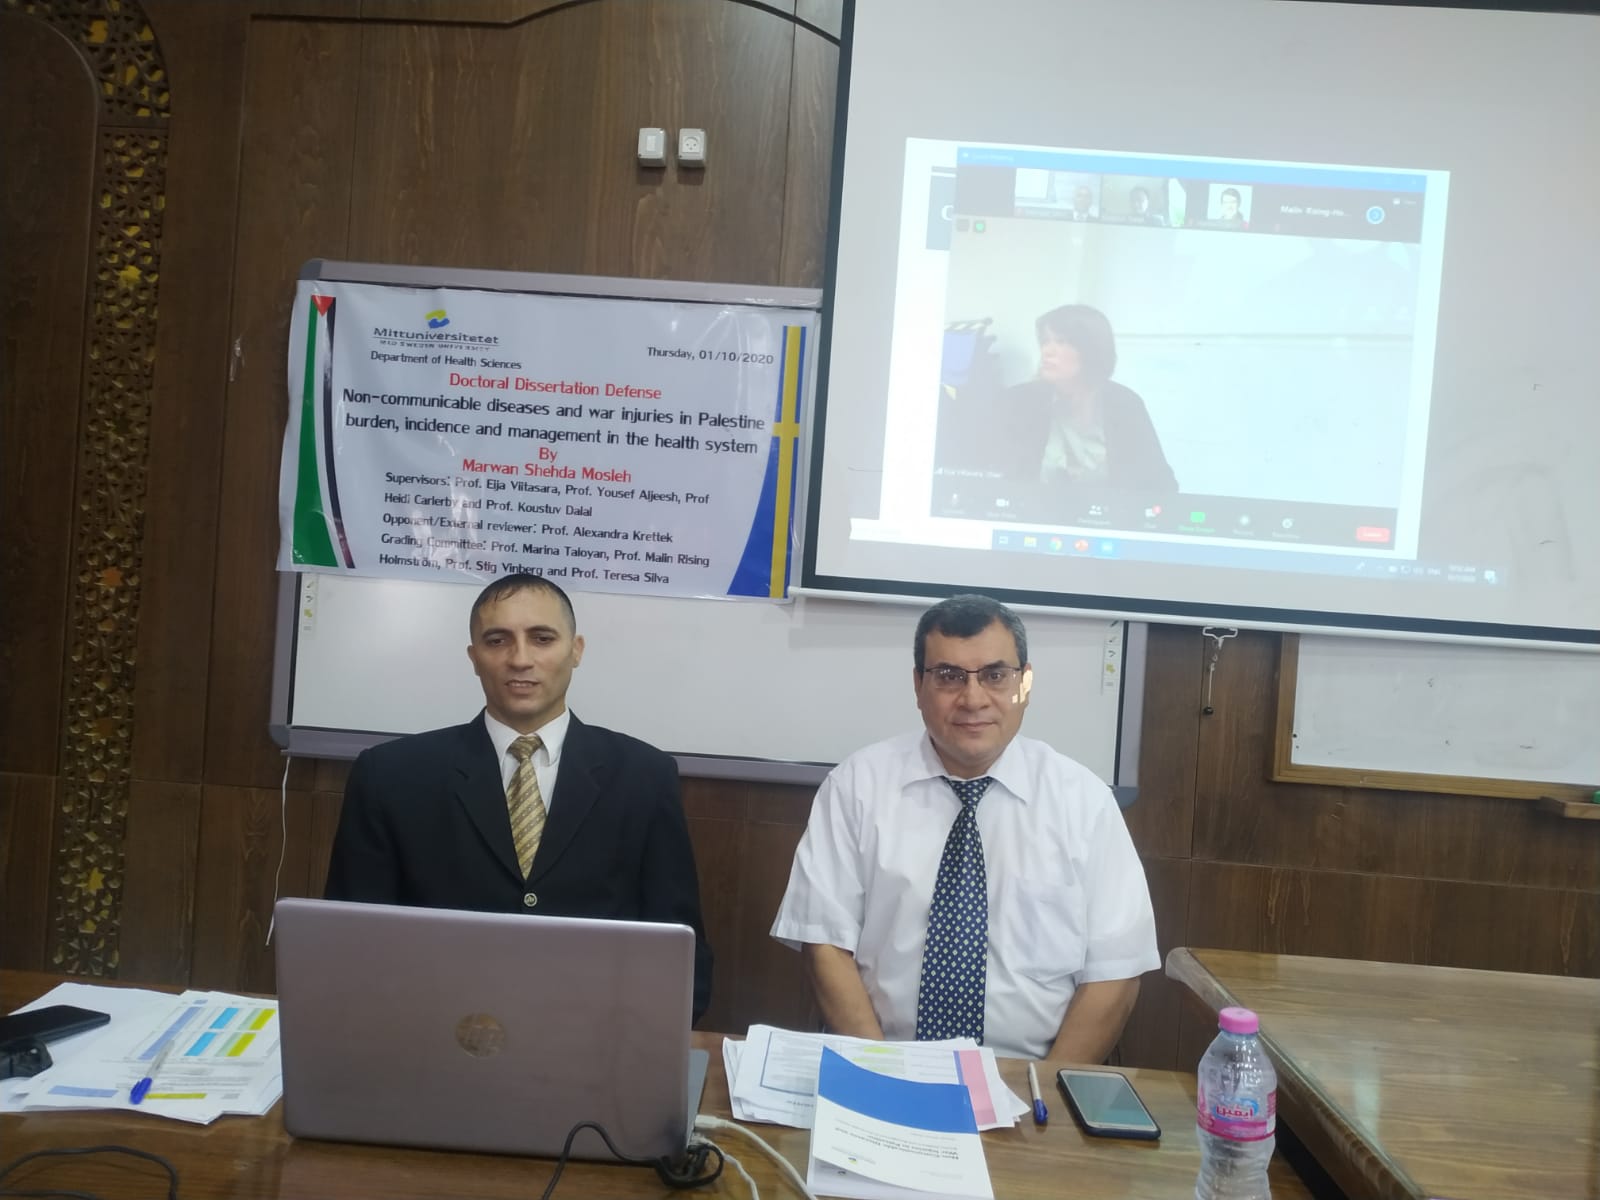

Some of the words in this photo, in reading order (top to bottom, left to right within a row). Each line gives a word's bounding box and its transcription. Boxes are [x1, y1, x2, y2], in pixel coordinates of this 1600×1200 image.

[374, 327, 499, 344] Mittuniversitetet
[400, 341, 435, 349] SWEDEN
[371, 350, 428, 364] Department
[431, 355, 442, 364] of
[445, 355, 476, 367] Health
[480, 358, 522, 370] Sciences
[648, 347, 695, 361] Thursday,
[699, 350, 774, 364] 01/10/2020
[450, 372, 509, 390] Doctoral
[515, 376, 599, 396] Dissertation
[605, 383, 662, 399] Defense
[343, 388, 481, 411] Non-communicable
[487, 397, 549, 416] diseases
[556, 404, 582, 418] and
[589, 408, 615, 419] war
[621, 407, 673, 424] injuries
[680, 410, 692, 425] in
[698, 412, 765, 430] Palestine
[346, 412, 399, 432] burden,
[405, 416, 470, 434] incidence
[475, 423, 502, 437] and
[508, 425, 601, 443] management
[607, 430, 619, 444] in
[626, 431, 649, 446] the
[655, 434, 699, 450] health
[705, 439, 758, 454] system
[539, 447, 558, 462] By
[462, 458, 518, 475] Marwan
[525, 463, 576, 479] Shehda
[582, 467, 631, 482] Mosleh
[386, 472, 450, 486] Supervisors:
[455, 476, 481, 489] Prof.
[486, 479, 506, 492] Eija
[510, 481, 560, 496] Viitasara,
[566, 484, 592, 497] Prof.
[597, 486, 635, 499] Yousef
[639, 489, 681, 504] Aljeesh,
[685, 493, 710, 504] Prof
[384, 492, 410, 504] Heidi
[414, 494, 458, 508] Carlerby
[462, 499, 481, 509] and
[486, 499, 513, 512] Prof.
[518, 502, 561, 515] Koustuv
[566, 505, 593, 517] Dalal
[382, 513, 483, 530] Opponent/External
[487, 520, 537, 534] reviewer:
[541, 524, 568, 536] Prof.
[573, 527, 629, 541] Alexandra
[632, 530, 673, 543] Krettek
[381, 533, 422, 548] Grading
[427, 537, 486, 550] Committee:
[491, 541, 518, 553] Prof.
[522, 543, 560, 556] Marina
[564, 545, 609, 561] Taloyan,
[614, 549, 640, 562] Prof.
[645, 551, 673, 564] Malin
[677, 553, 710, 567] Rising
[379, 554, 441, 570] Holmström,
[445, 558, 471, 571] Prof.
[475, 560, 497, 574] Stig
[502, 562, 543, 576] Vinberg
[547, 566, 567, 577] and
[571, 567, 598, 579] Prof.
[602, 569, 640, 582] Teresa
[644, 572, 669, 584] Silva
